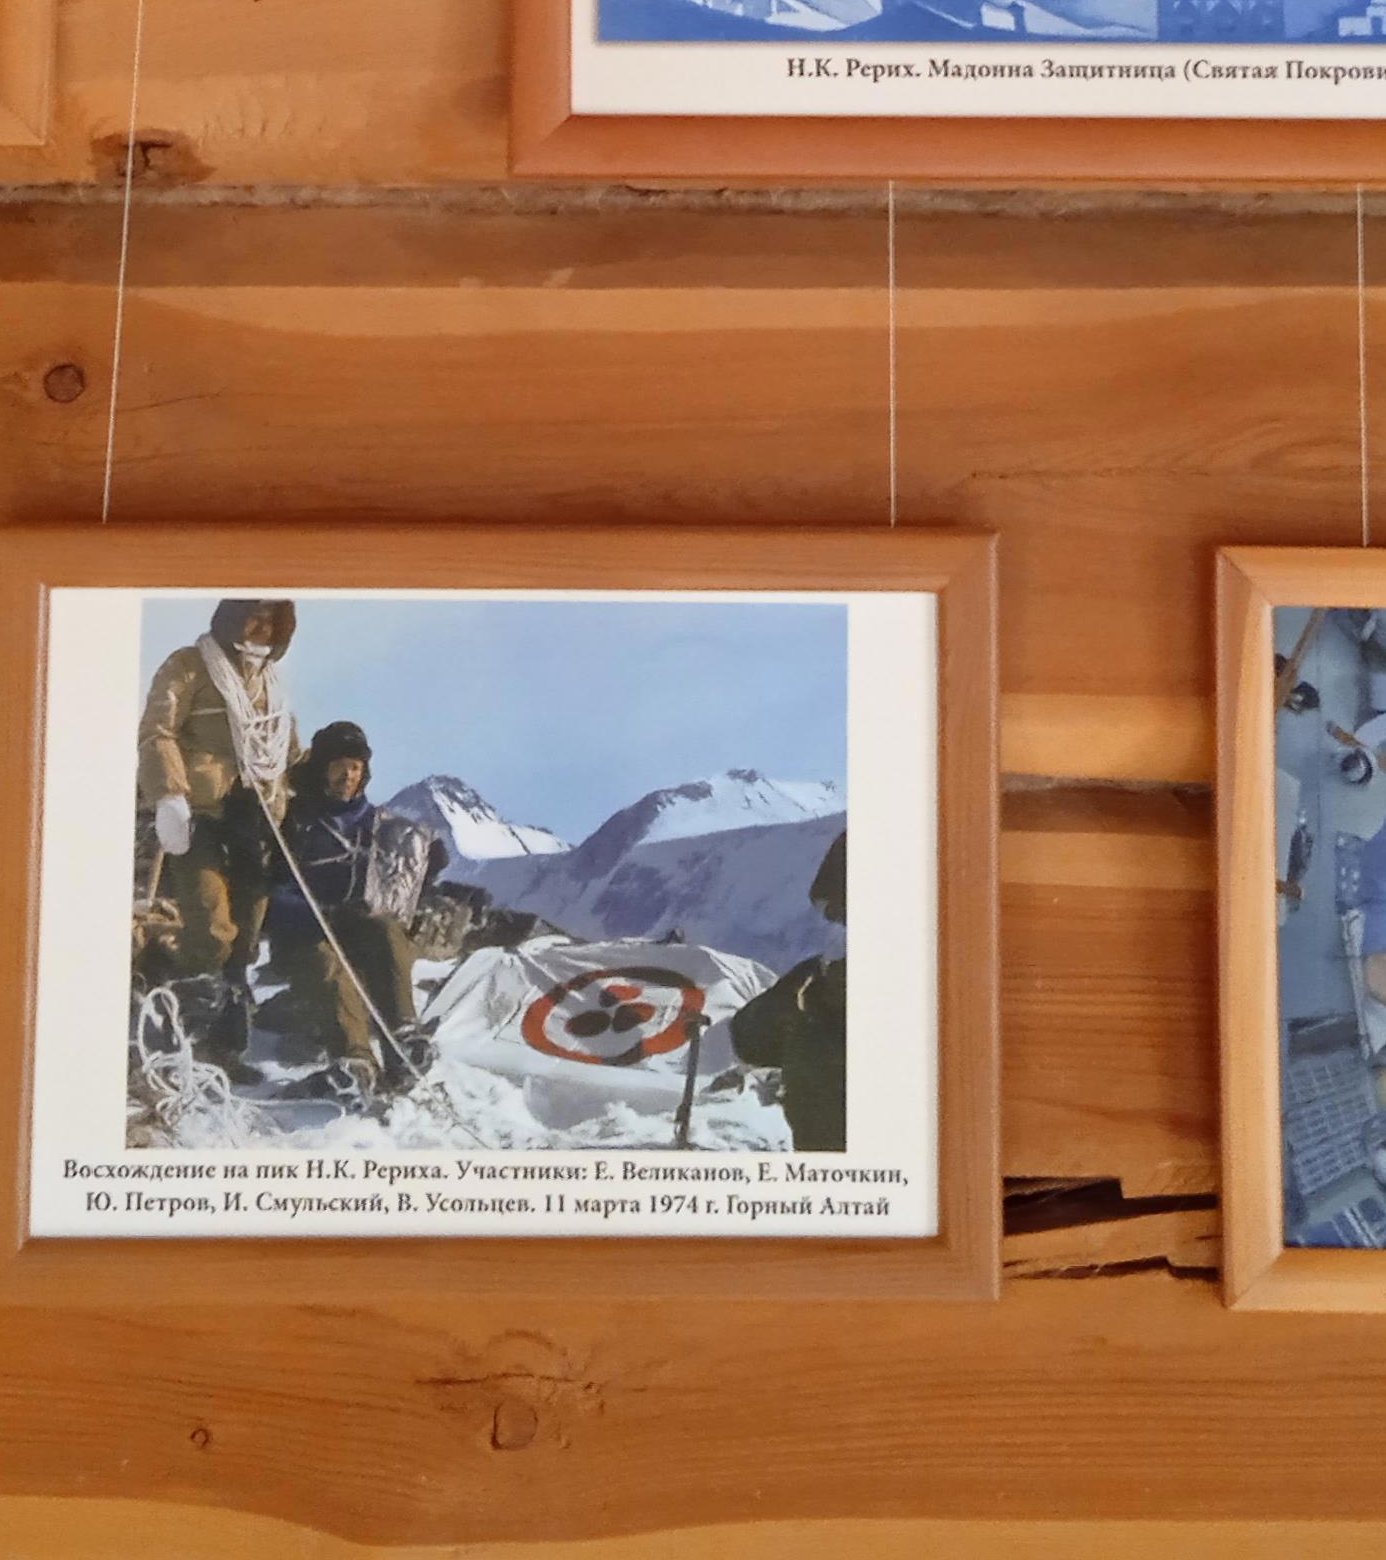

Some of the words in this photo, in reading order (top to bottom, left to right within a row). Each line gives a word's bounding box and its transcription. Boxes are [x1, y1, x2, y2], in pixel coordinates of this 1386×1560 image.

[787, 57, 839, 78] Н.К.
[846, 58, 922, 83] Рерих.
[928, 59, 1034, 81] Мадонна
[1040, 59, 1176, 82] Защитница
[1183, 59, 1278, 82] (Святая
[63, 1159, 216, 1182] Восхождение
[223, 1165, 249, 1179] на
[256, 1164, 299, 1179] пик
[306, 1159, 356, 1179] Н.К.
[363, 1160, 449, 1186] Рериха.
[455, 1160, 587, 1181] Участники:
[595, 1161, 614, 1181] Е.
[622, 1161, 751, 1185] Великанов,
[758, 1162, 778, 1182] Е.
[785, 1162, 908, 1186] Маточкин,
[86, 1191, 117, 1211] Ю.
[125, 1191, 216, 1218] Петров,
[223, 1192, 248, 1212] И.
[255, 1192, 389, 1219] Смульский,
[397, 1192, 418, 1213] В.
[425, 1192, 536, 1215] Усольцев.
[545, 1194, 565, 1213] 11
[574, 1198, 641, 1219] марта
[650, 1194, 699, 1214] 1974
[706, 1200, 719, 1214] г.
[727, 1194, 812, 1221] Горный
[819, 1197, 890, 1216] Алтай
